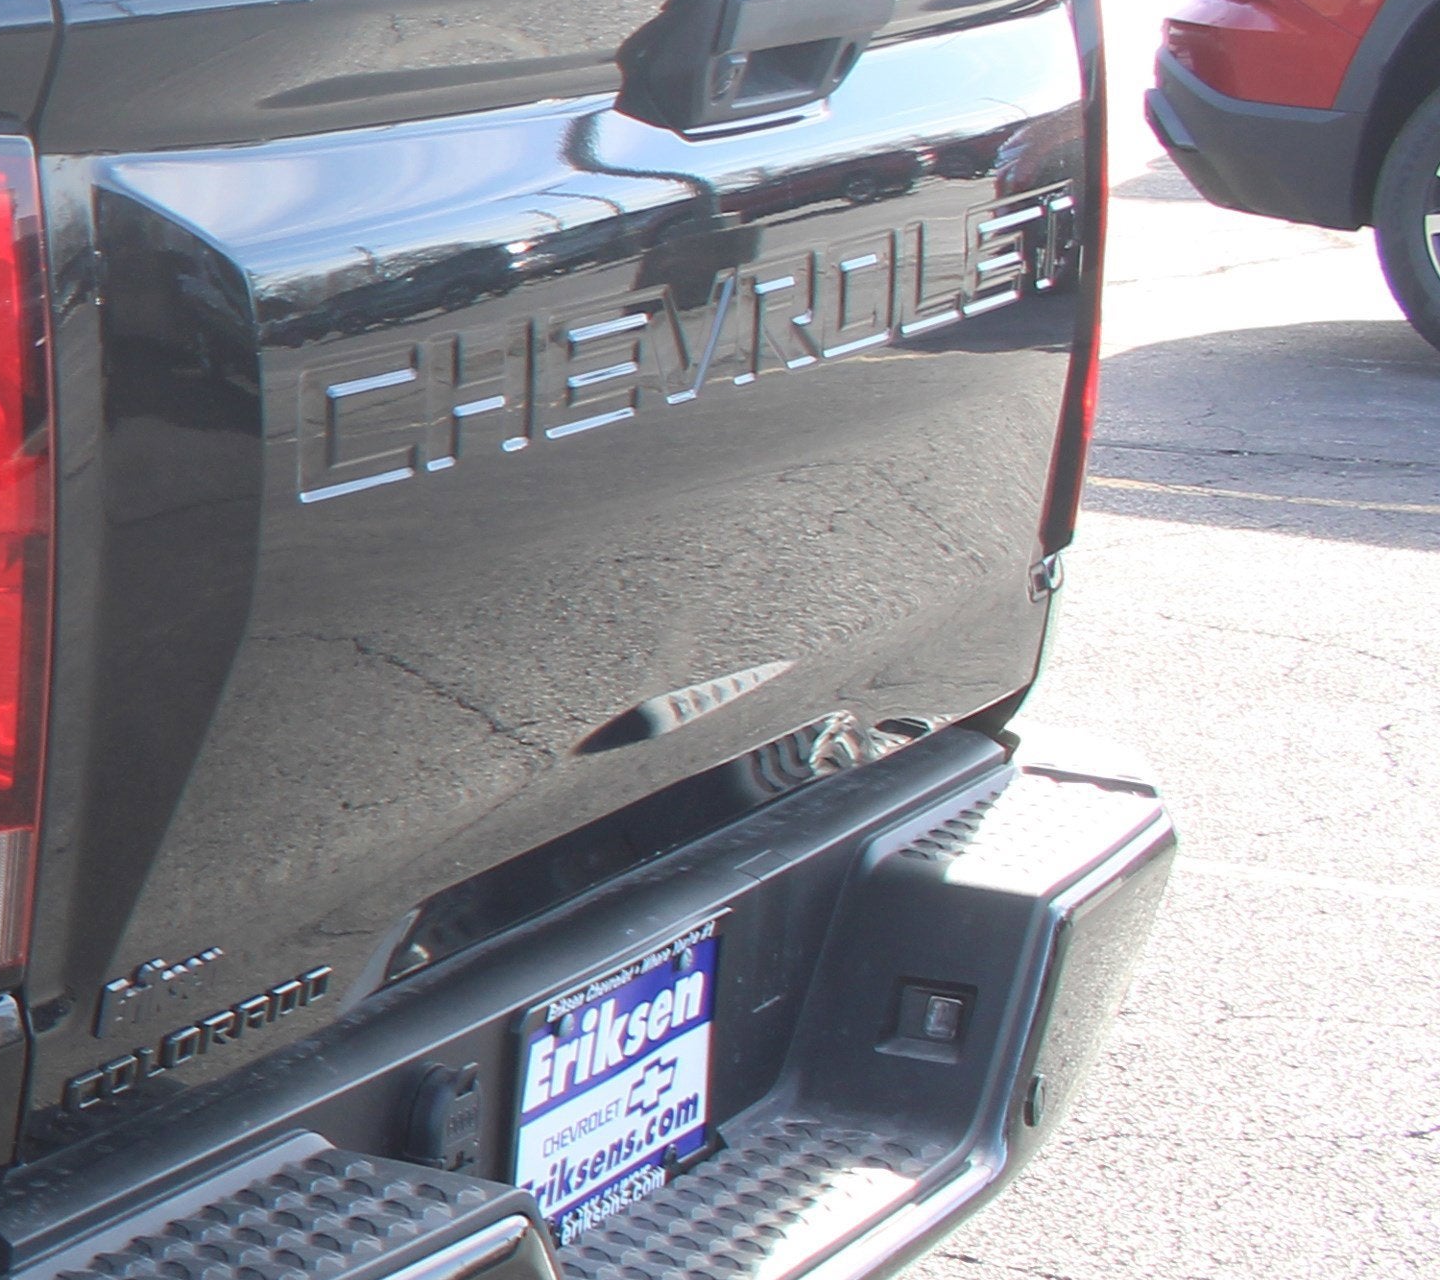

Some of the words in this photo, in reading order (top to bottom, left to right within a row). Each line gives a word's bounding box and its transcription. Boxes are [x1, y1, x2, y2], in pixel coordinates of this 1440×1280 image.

[297, 179, 1074, 504] CHEVROLET
[63, 965, 333, 1112] COLORADO
[520, 970, 705, 1114] Eriksen
[542, 1097, 623, 1158] CHEVROLET
